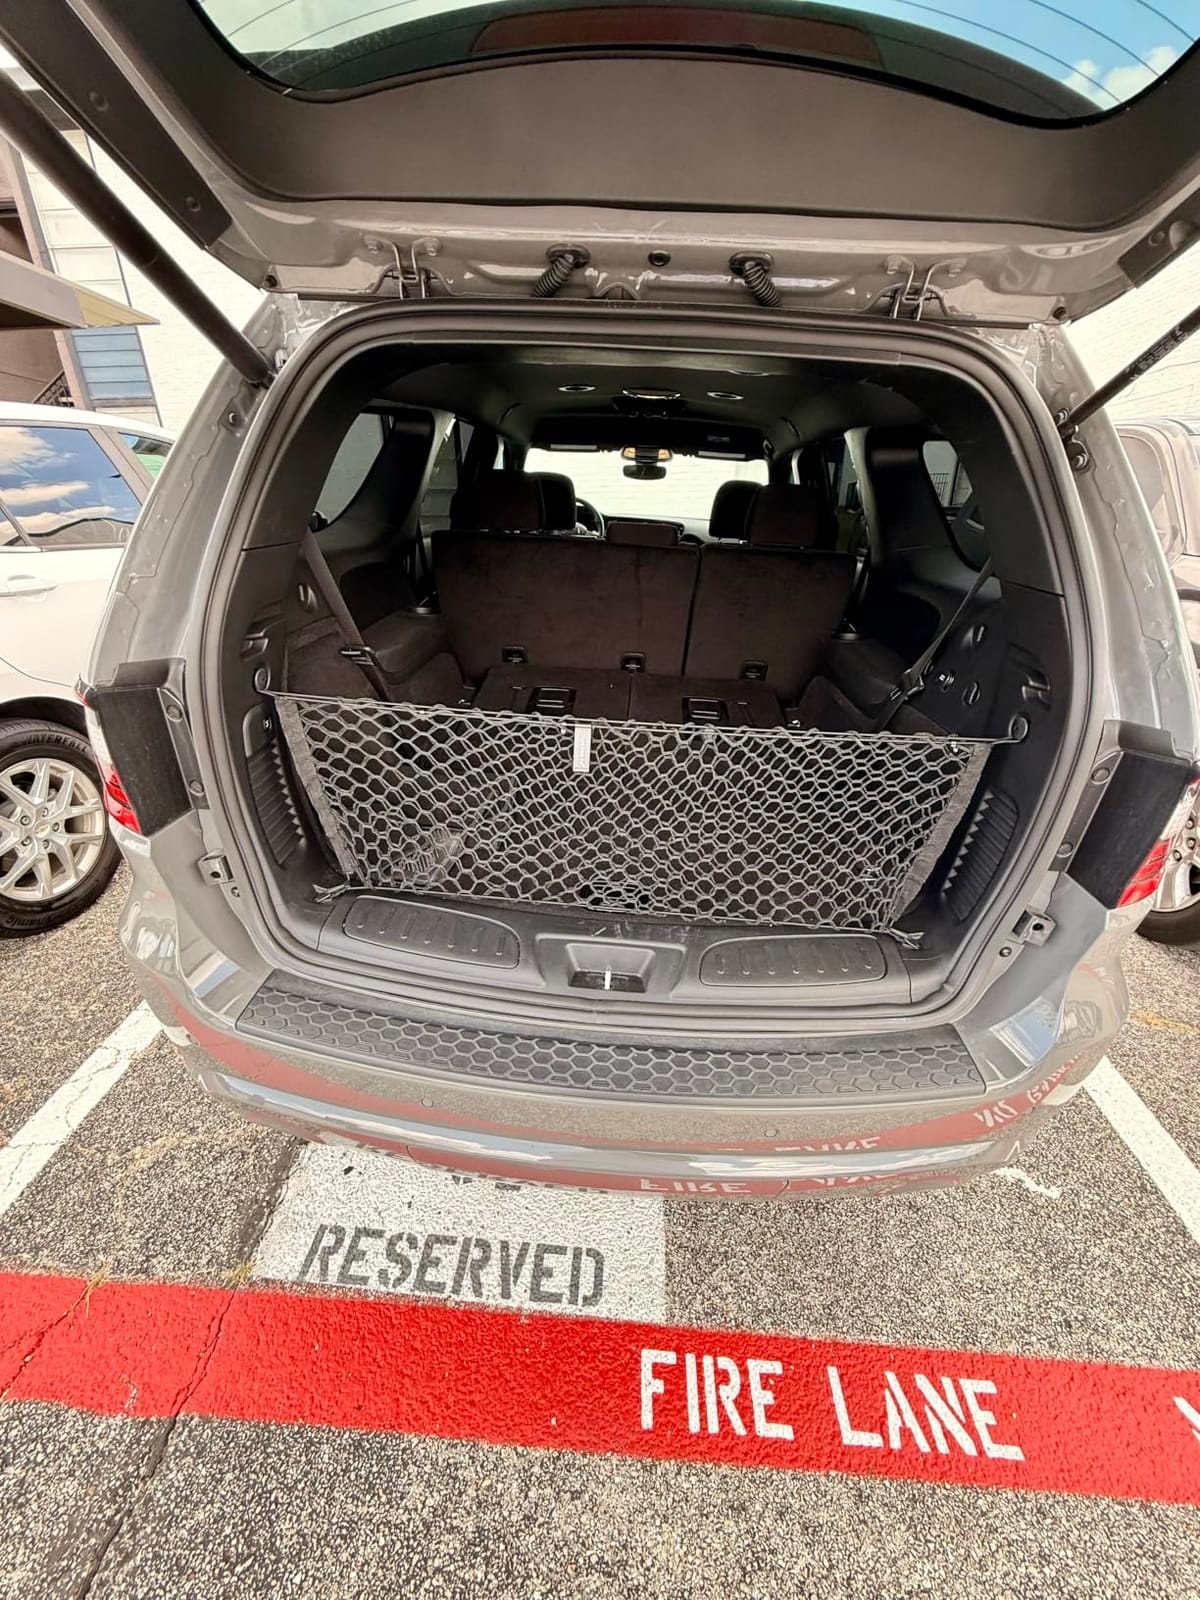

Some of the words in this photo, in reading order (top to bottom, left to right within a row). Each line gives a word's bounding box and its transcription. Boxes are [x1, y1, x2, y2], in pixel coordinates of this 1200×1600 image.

[21, 733, 88, 753] WATERFALL
[299, 1223, 604, 1308] RESERVED
[640, 1348, 795, 1441] FIRE
[826, 1365, 1026, 1462] LANE
